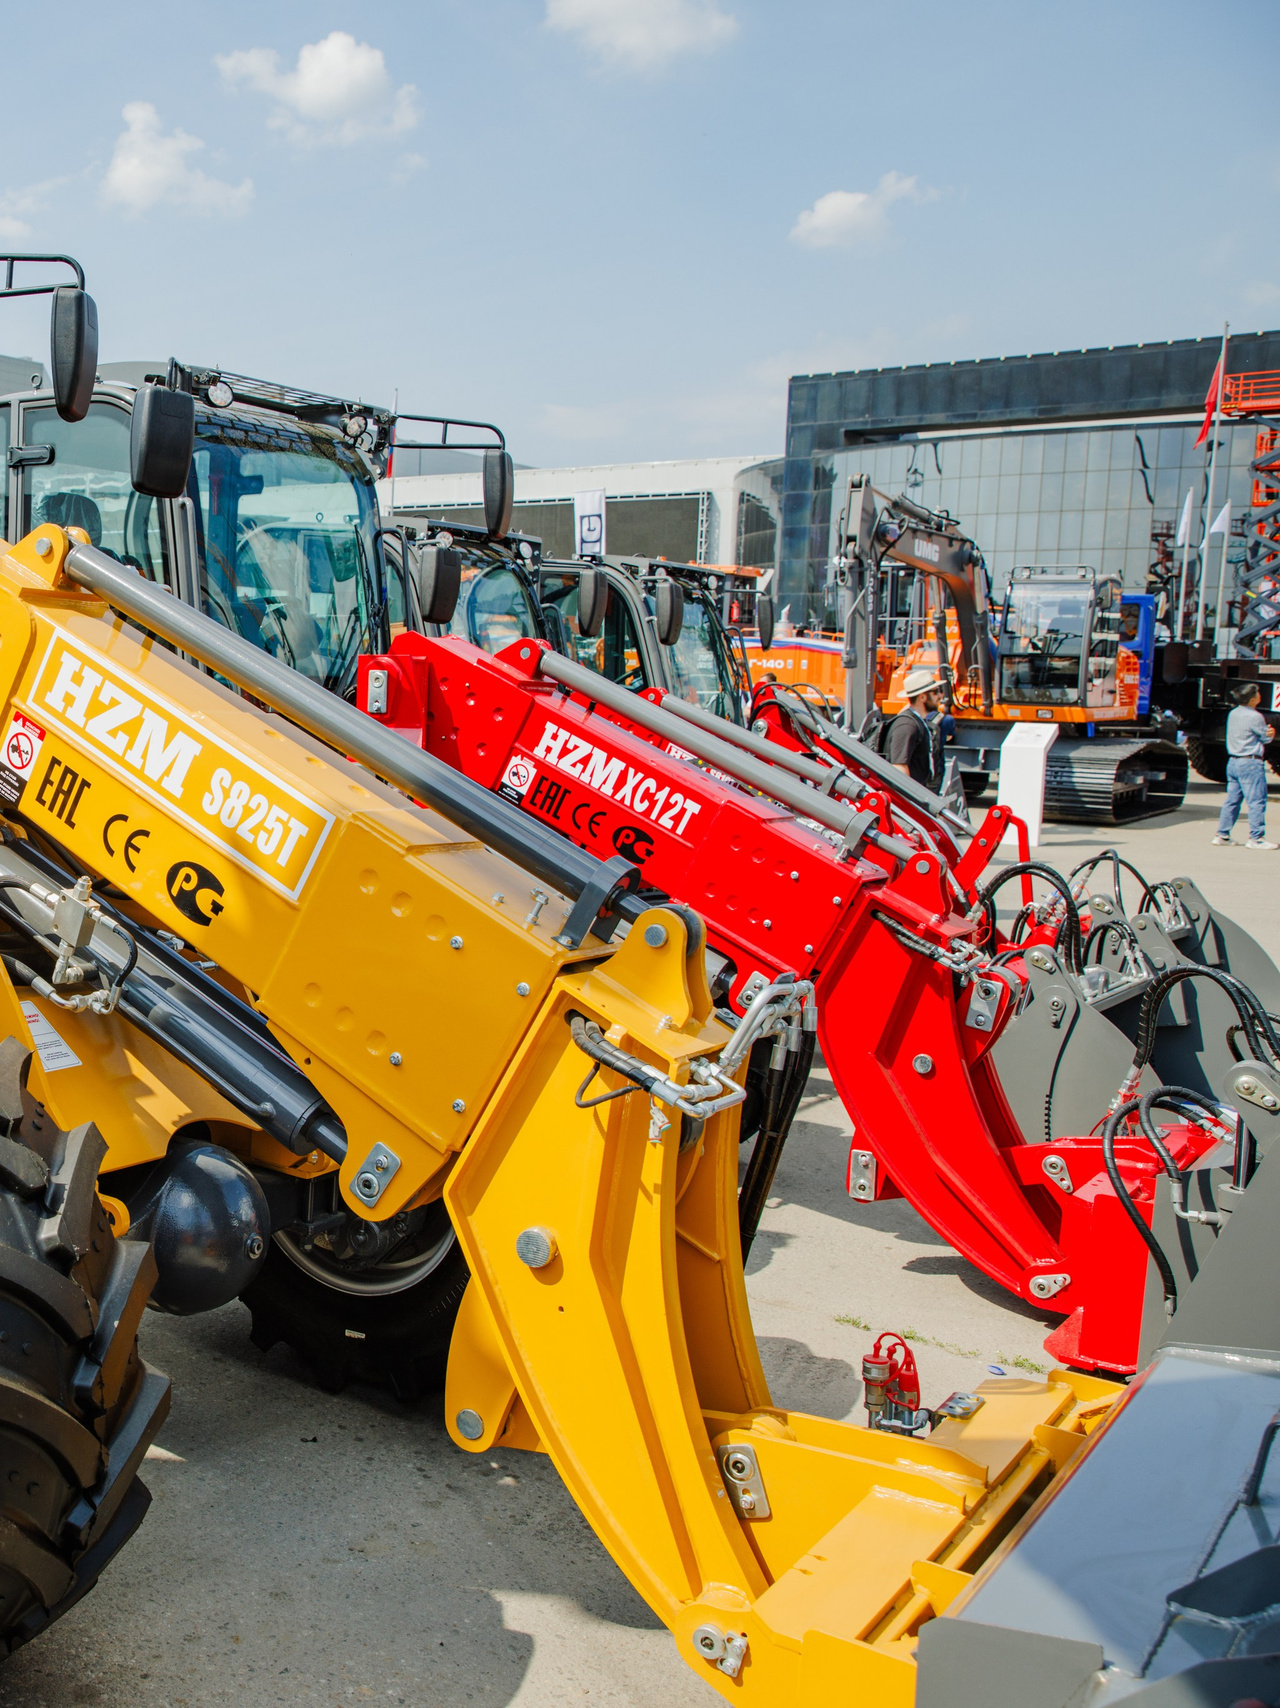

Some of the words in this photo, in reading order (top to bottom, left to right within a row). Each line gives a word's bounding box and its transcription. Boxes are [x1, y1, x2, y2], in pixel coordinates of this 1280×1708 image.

[914, 538, 940, 562] UMG
[44, 650, 202, 799] HZM
[202, 768, 309, 868] S825T
[533, 721, 627, 796] HZM
[614, 767, 702, 835] XC12T
[102, 814, 151, 873] CE
[571, 803, 607, 838] CE
